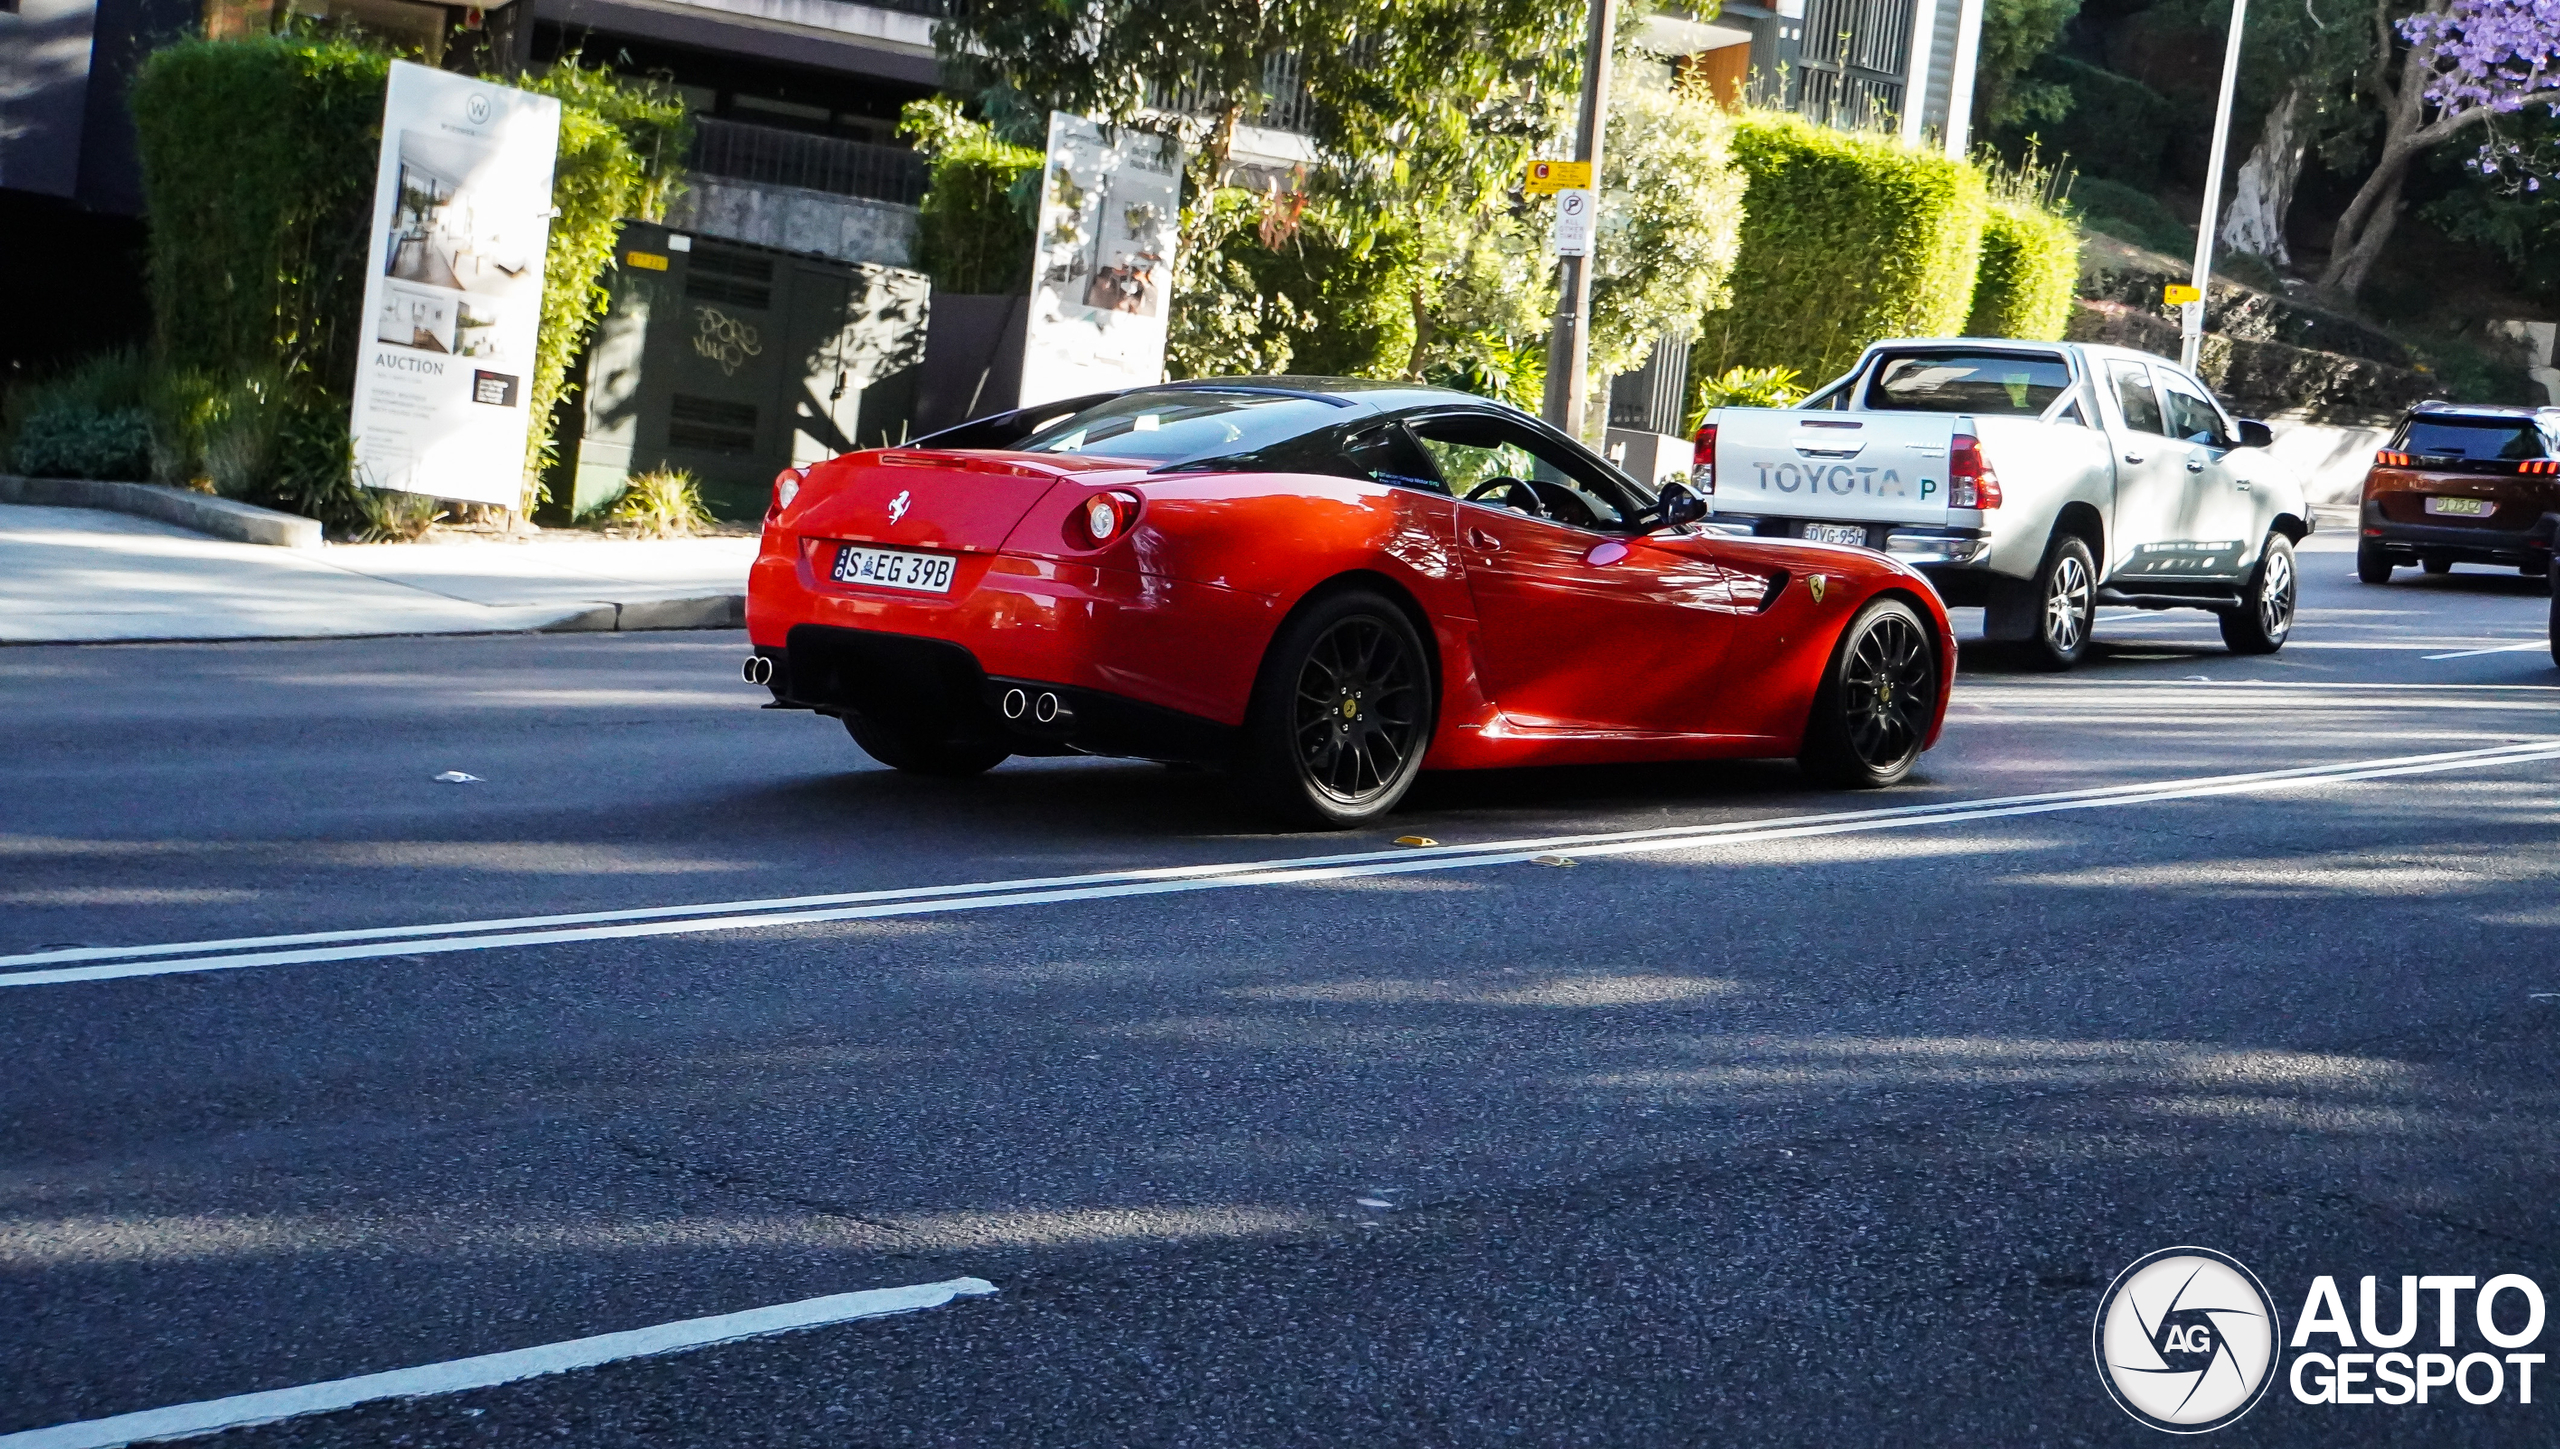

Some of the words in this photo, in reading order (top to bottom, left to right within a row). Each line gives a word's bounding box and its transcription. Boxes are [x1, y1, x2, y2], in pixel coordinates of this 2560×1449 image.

[470, 101, 486, 116] W
[375, 353, 444, 375] AUCTION
[1753, 462, 1905, 497] TOYOTA
[1920, 479, 1937, 500] P
[907, 558, 951, 587] 39B
